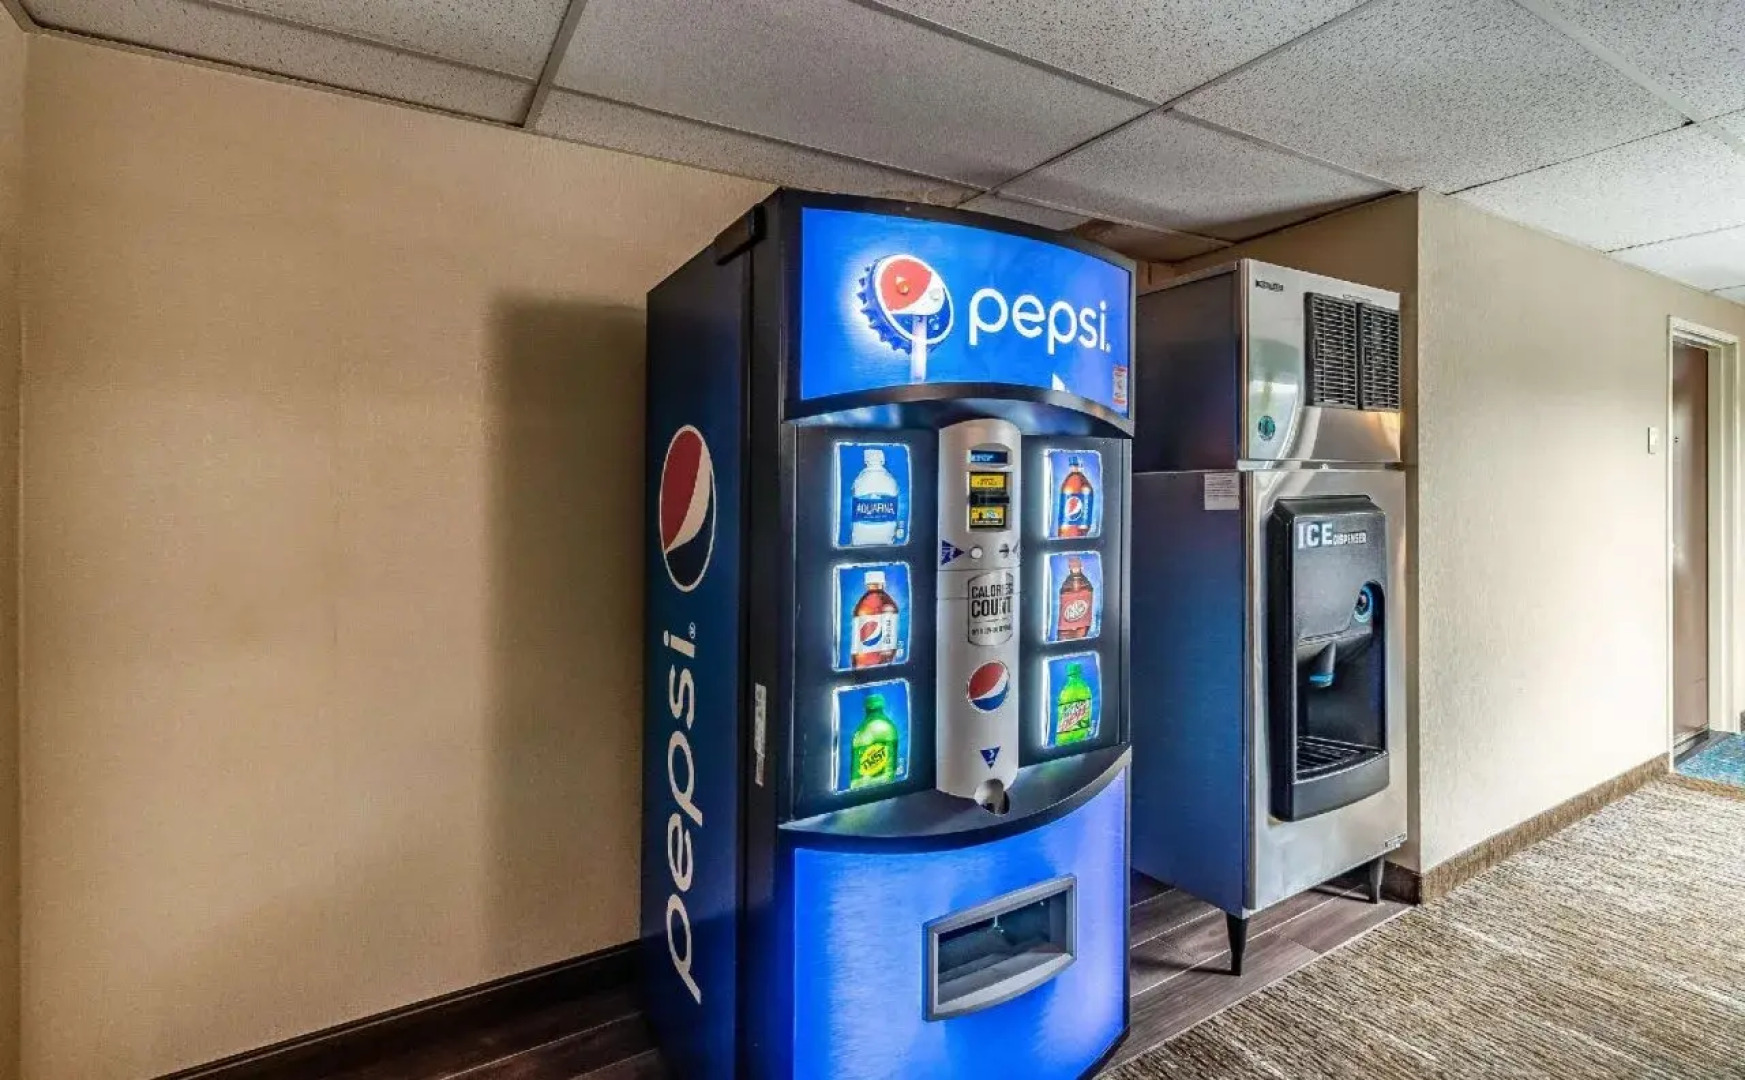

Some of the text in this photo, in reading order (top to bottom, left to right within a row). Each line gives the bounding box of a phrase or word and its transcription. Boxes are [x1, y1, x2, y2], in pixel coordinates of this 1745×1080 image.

[969, 288, 1107, 355] pepsi
[1297, 523, 1333, 549] ICE
[664, 630, 703, 1004] pepsi
